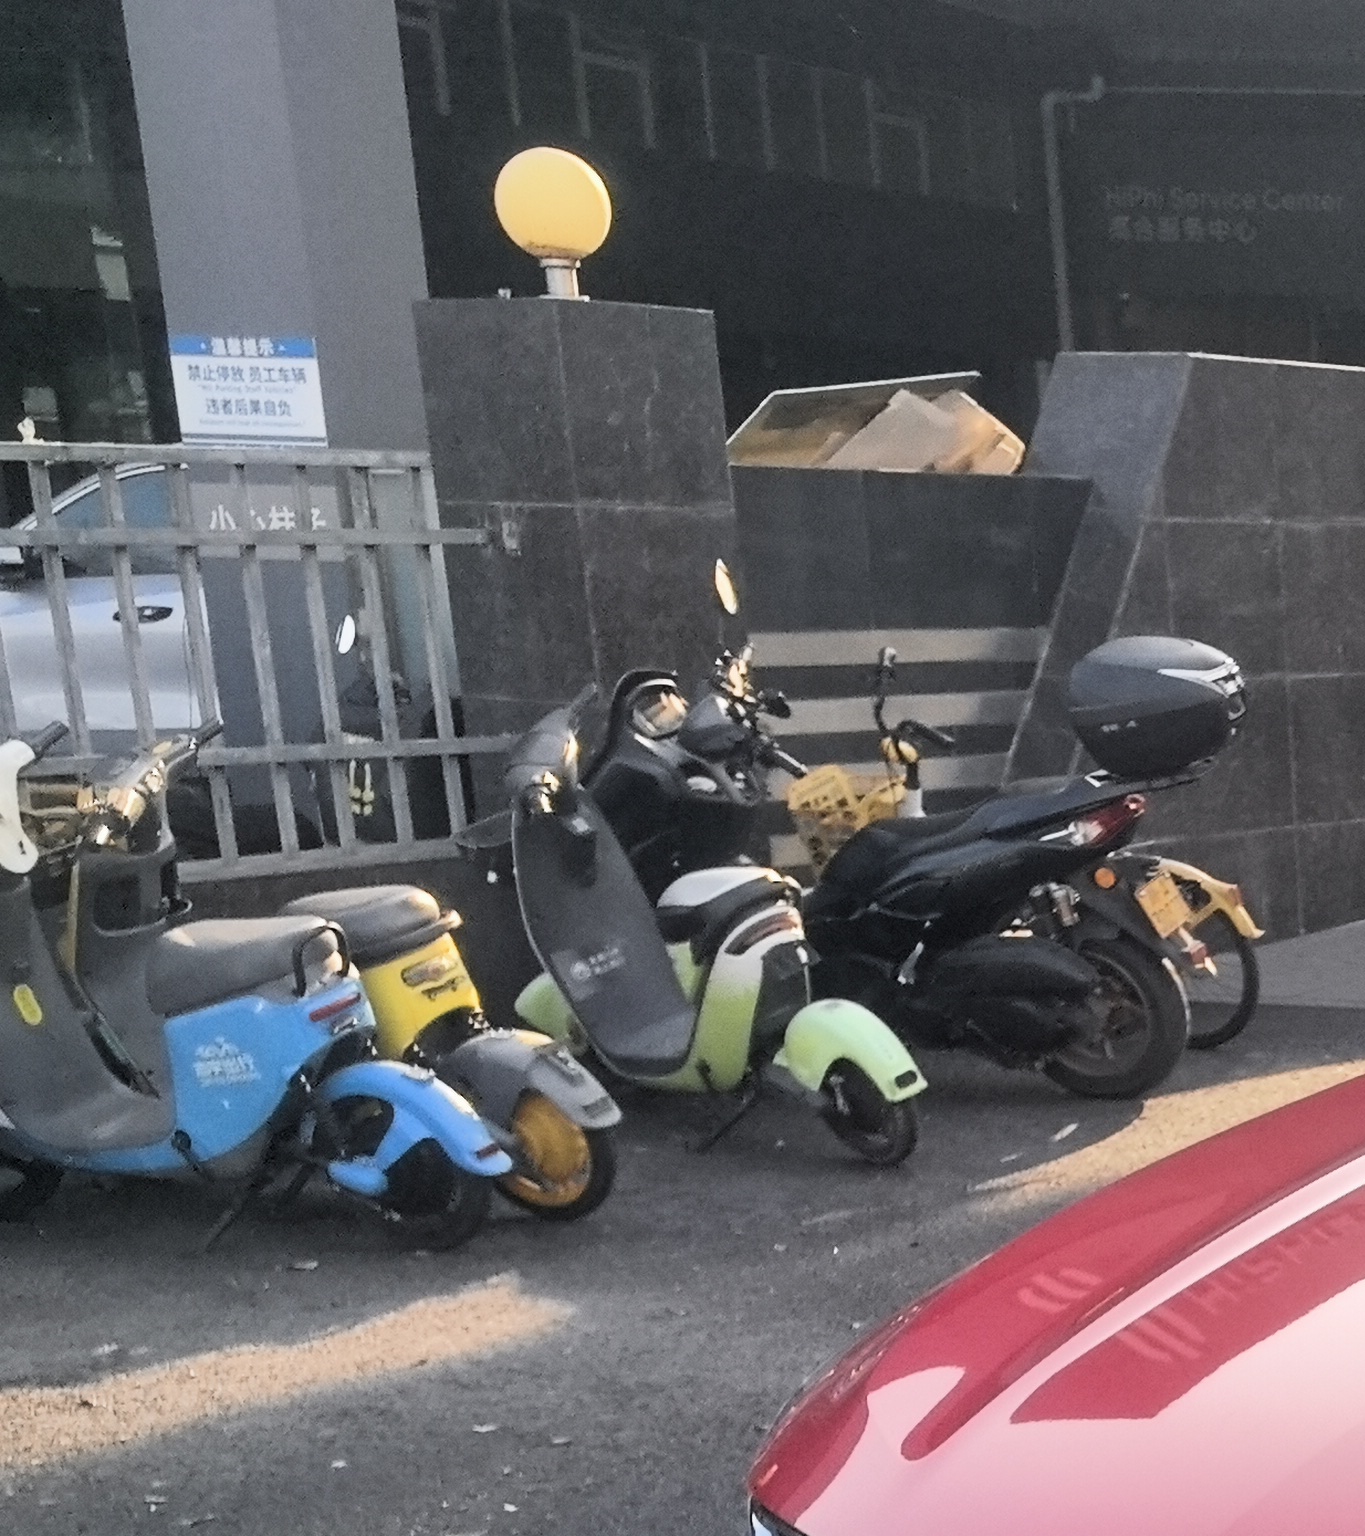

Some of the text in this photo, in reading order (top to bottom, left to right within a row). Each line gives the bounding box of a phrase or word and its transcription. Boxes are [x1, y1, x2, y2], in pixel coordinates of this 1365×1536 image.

[187, 364, 307, 384] 禁止停放 员工车辆
[206, 398, 292, 416] 违者后果自负
